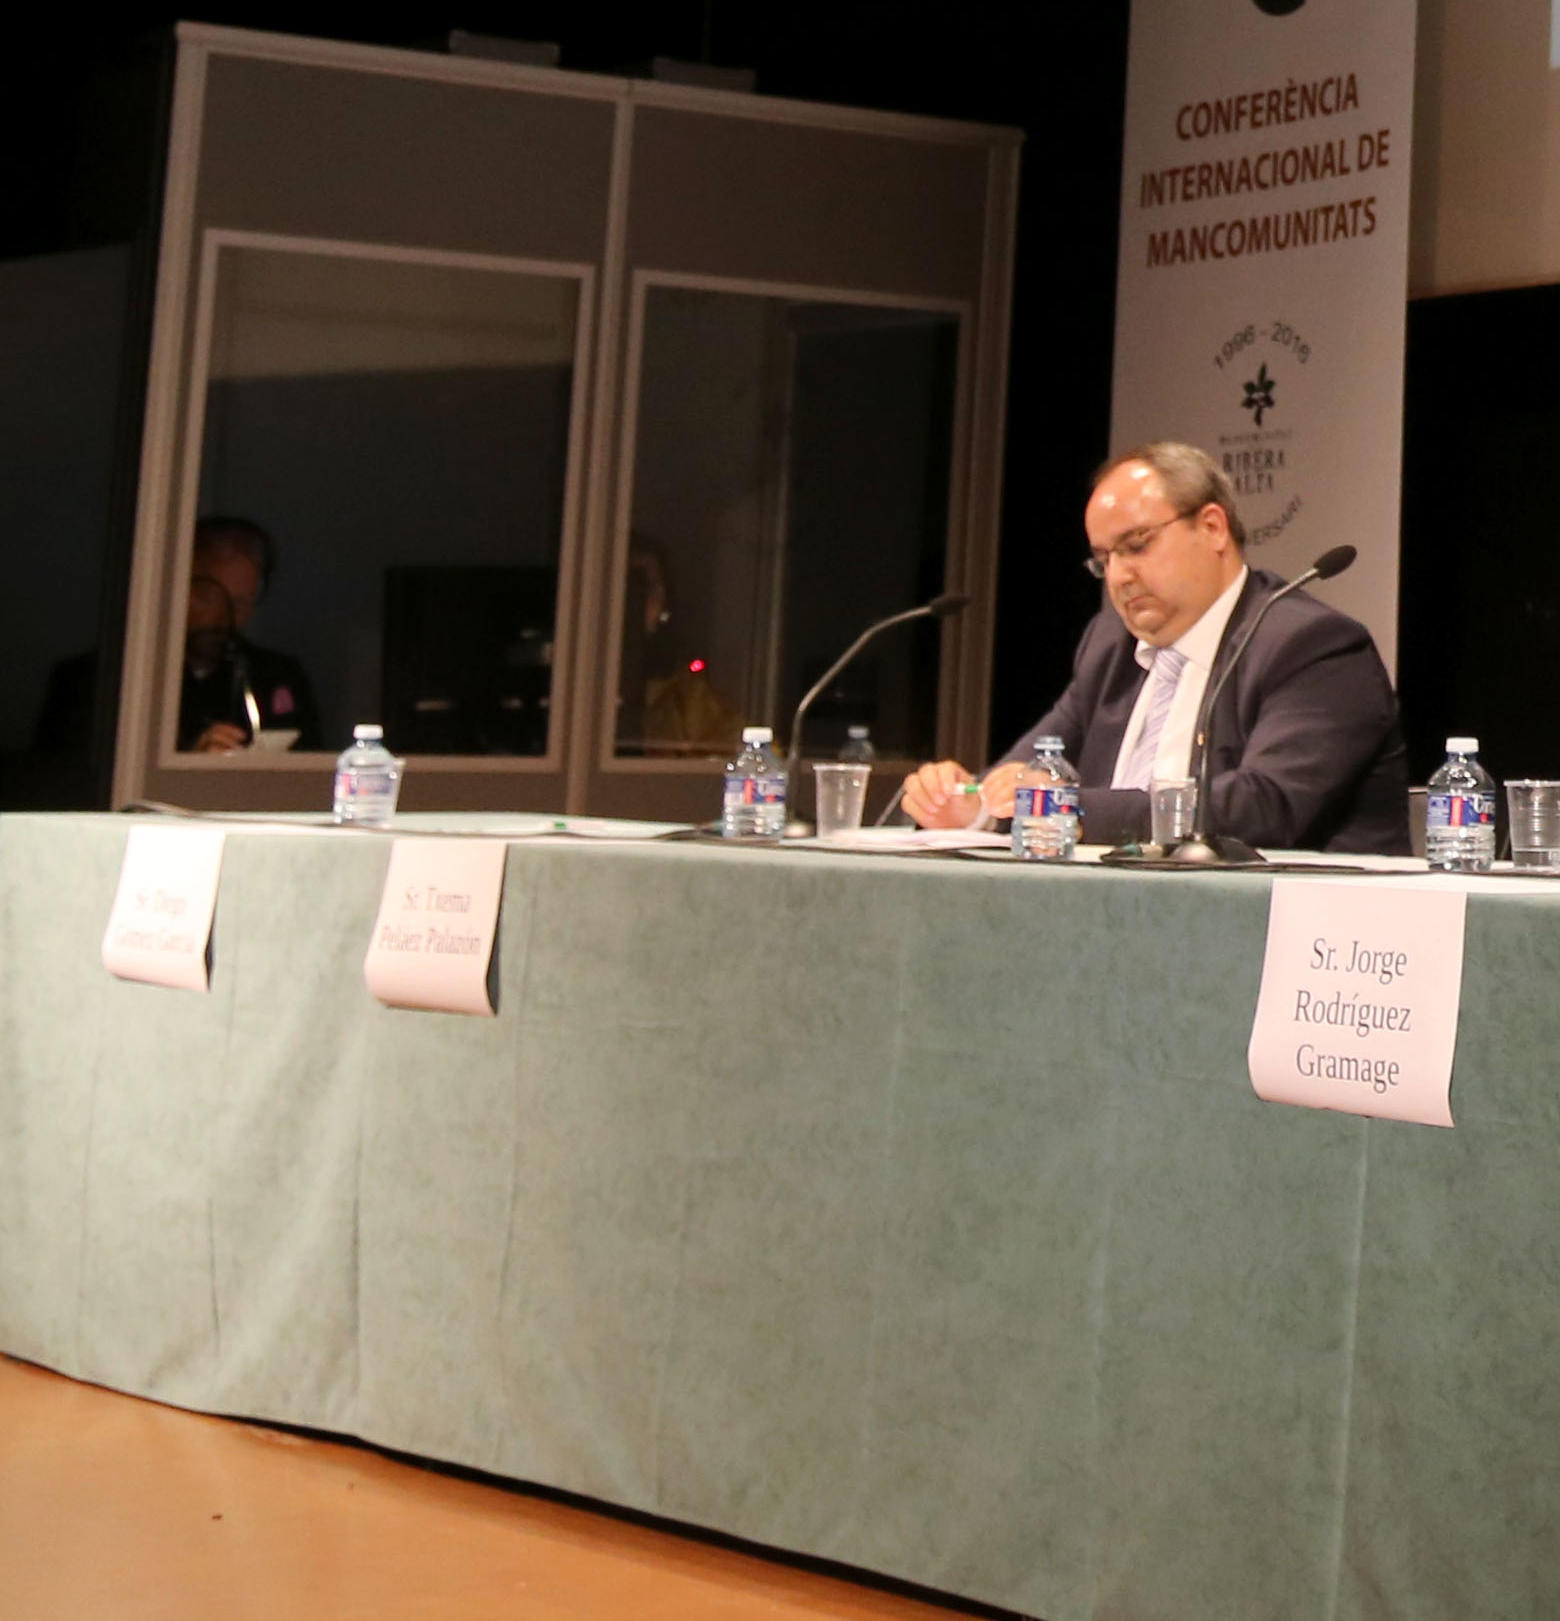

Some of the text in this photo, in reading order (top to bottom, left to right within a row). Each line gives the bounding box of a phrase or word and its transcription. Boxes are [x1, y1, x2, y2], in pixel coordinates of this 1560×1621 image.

[1175, 73, 1360, 142] CONFERÈNCIA
[1140, 128, 1392, 209] INTERNACIONAL DE
[1146, 195, 1378, 269] MANCOMUNITATS
[1310, 938, 1409, 986] Sr. Jorge
[1293, 989, 1412, 1037] Rodríguez
[1295, 1043, 1401, 1095] Gramage
